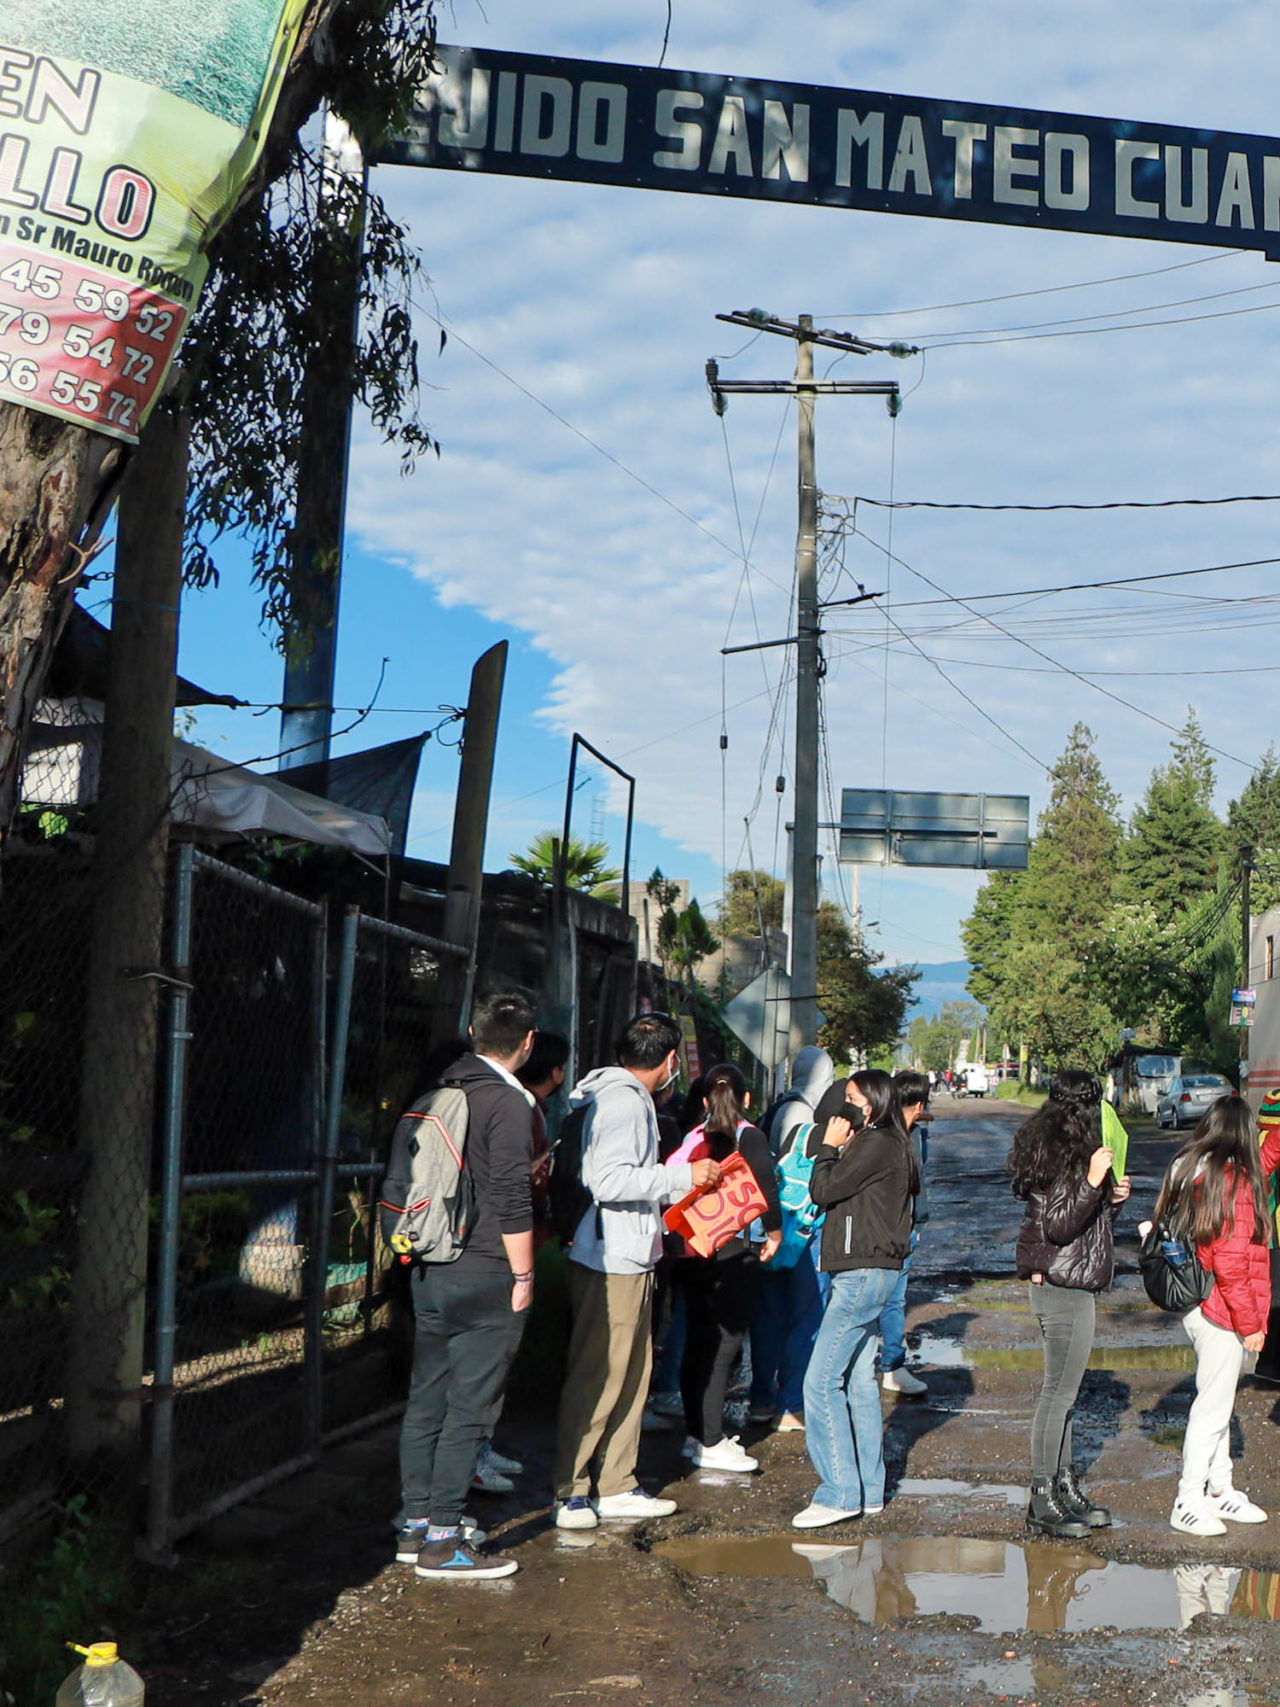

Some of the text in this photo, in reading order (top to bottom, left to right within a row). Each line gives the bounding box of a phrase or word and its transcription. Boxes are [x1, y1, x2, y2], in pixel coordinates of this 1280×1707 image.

[0, 46, 102, 136] EN
[0, 132, 157, 242] LLO
[653, 88, 810, 182] SAN
[835, 108, 1090, 211] MATEO
[17, 215, 47, 247] Sr
[51, 225, 133, 273] Mauro
[0, 258, 174, 342] 45 59 52
[0, 302, 155, 385] 79 54 72
[50, 370, 103, 413] 55
[107, 390, 137, 427] 72
